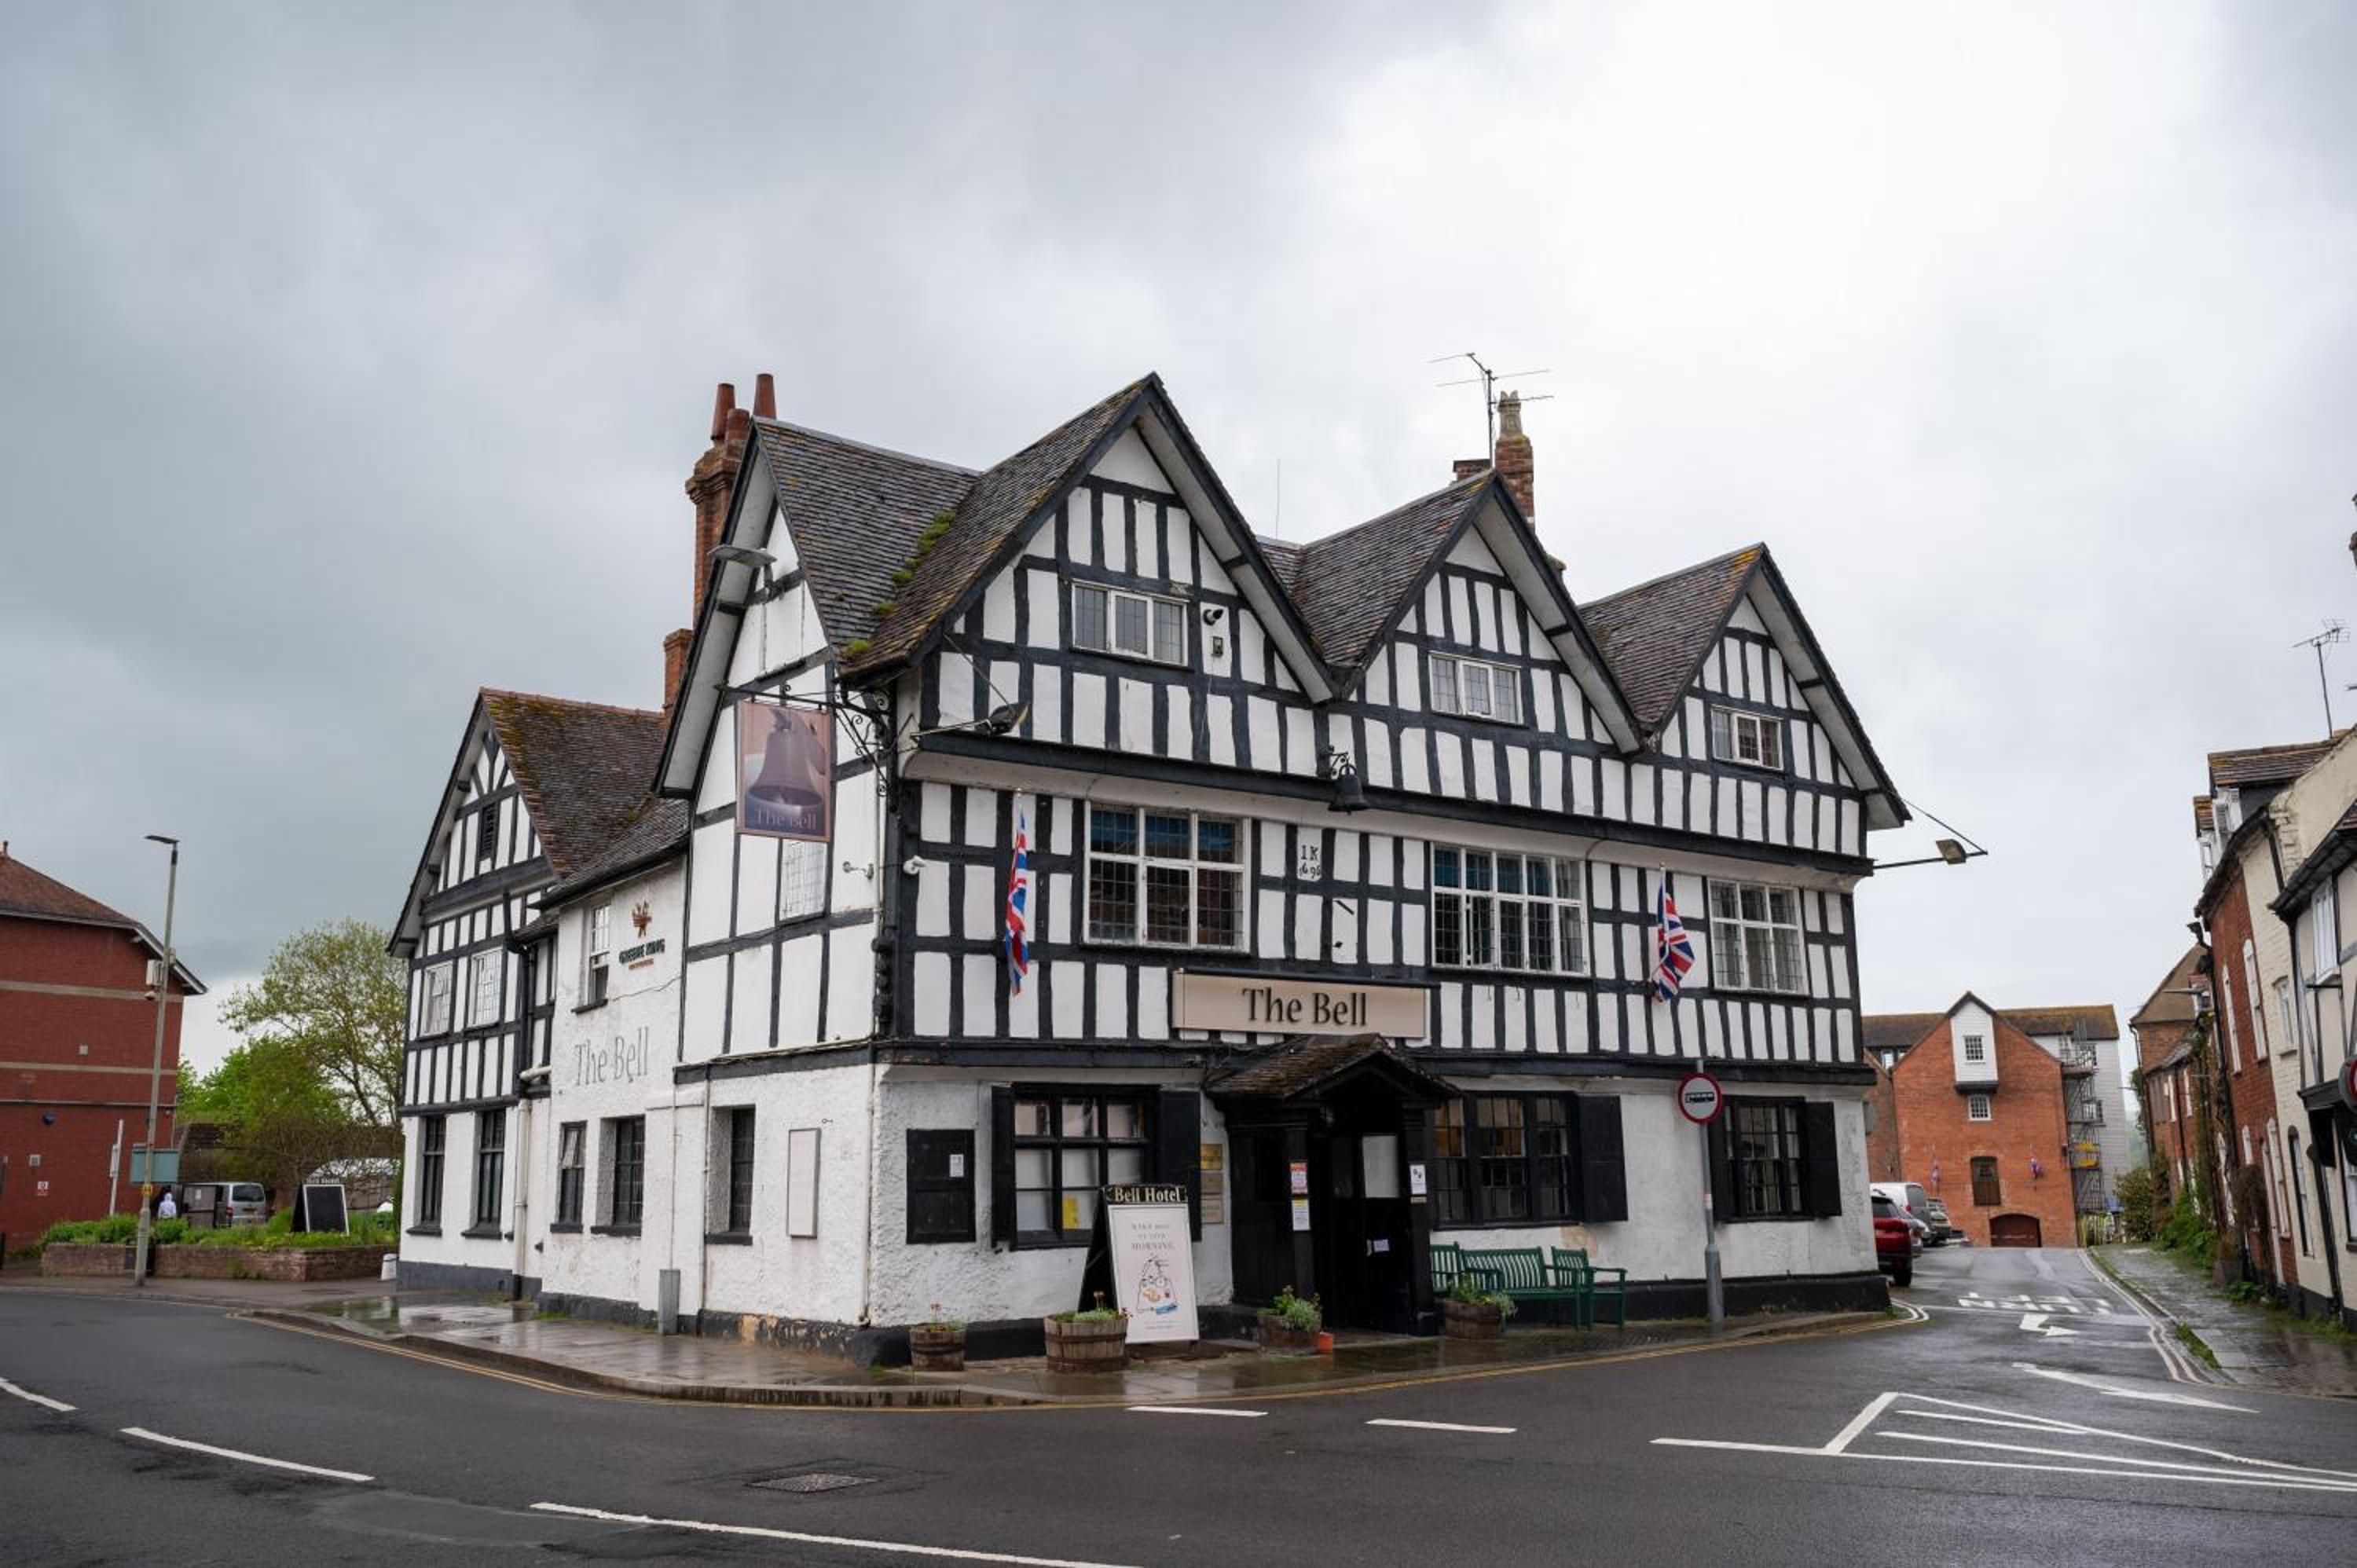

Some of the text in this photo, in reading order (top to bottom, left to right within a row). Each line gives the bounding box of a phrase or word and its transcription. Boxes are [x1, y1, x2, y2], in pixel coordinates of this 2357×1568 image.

[754, 807, 816, 830] The Bell
[1241, 985, 1367, 1026] The Bell
[574, 1026, 649, 1086] The Bell
[1114, 1187, 1181, 1203] Bell Hotel
